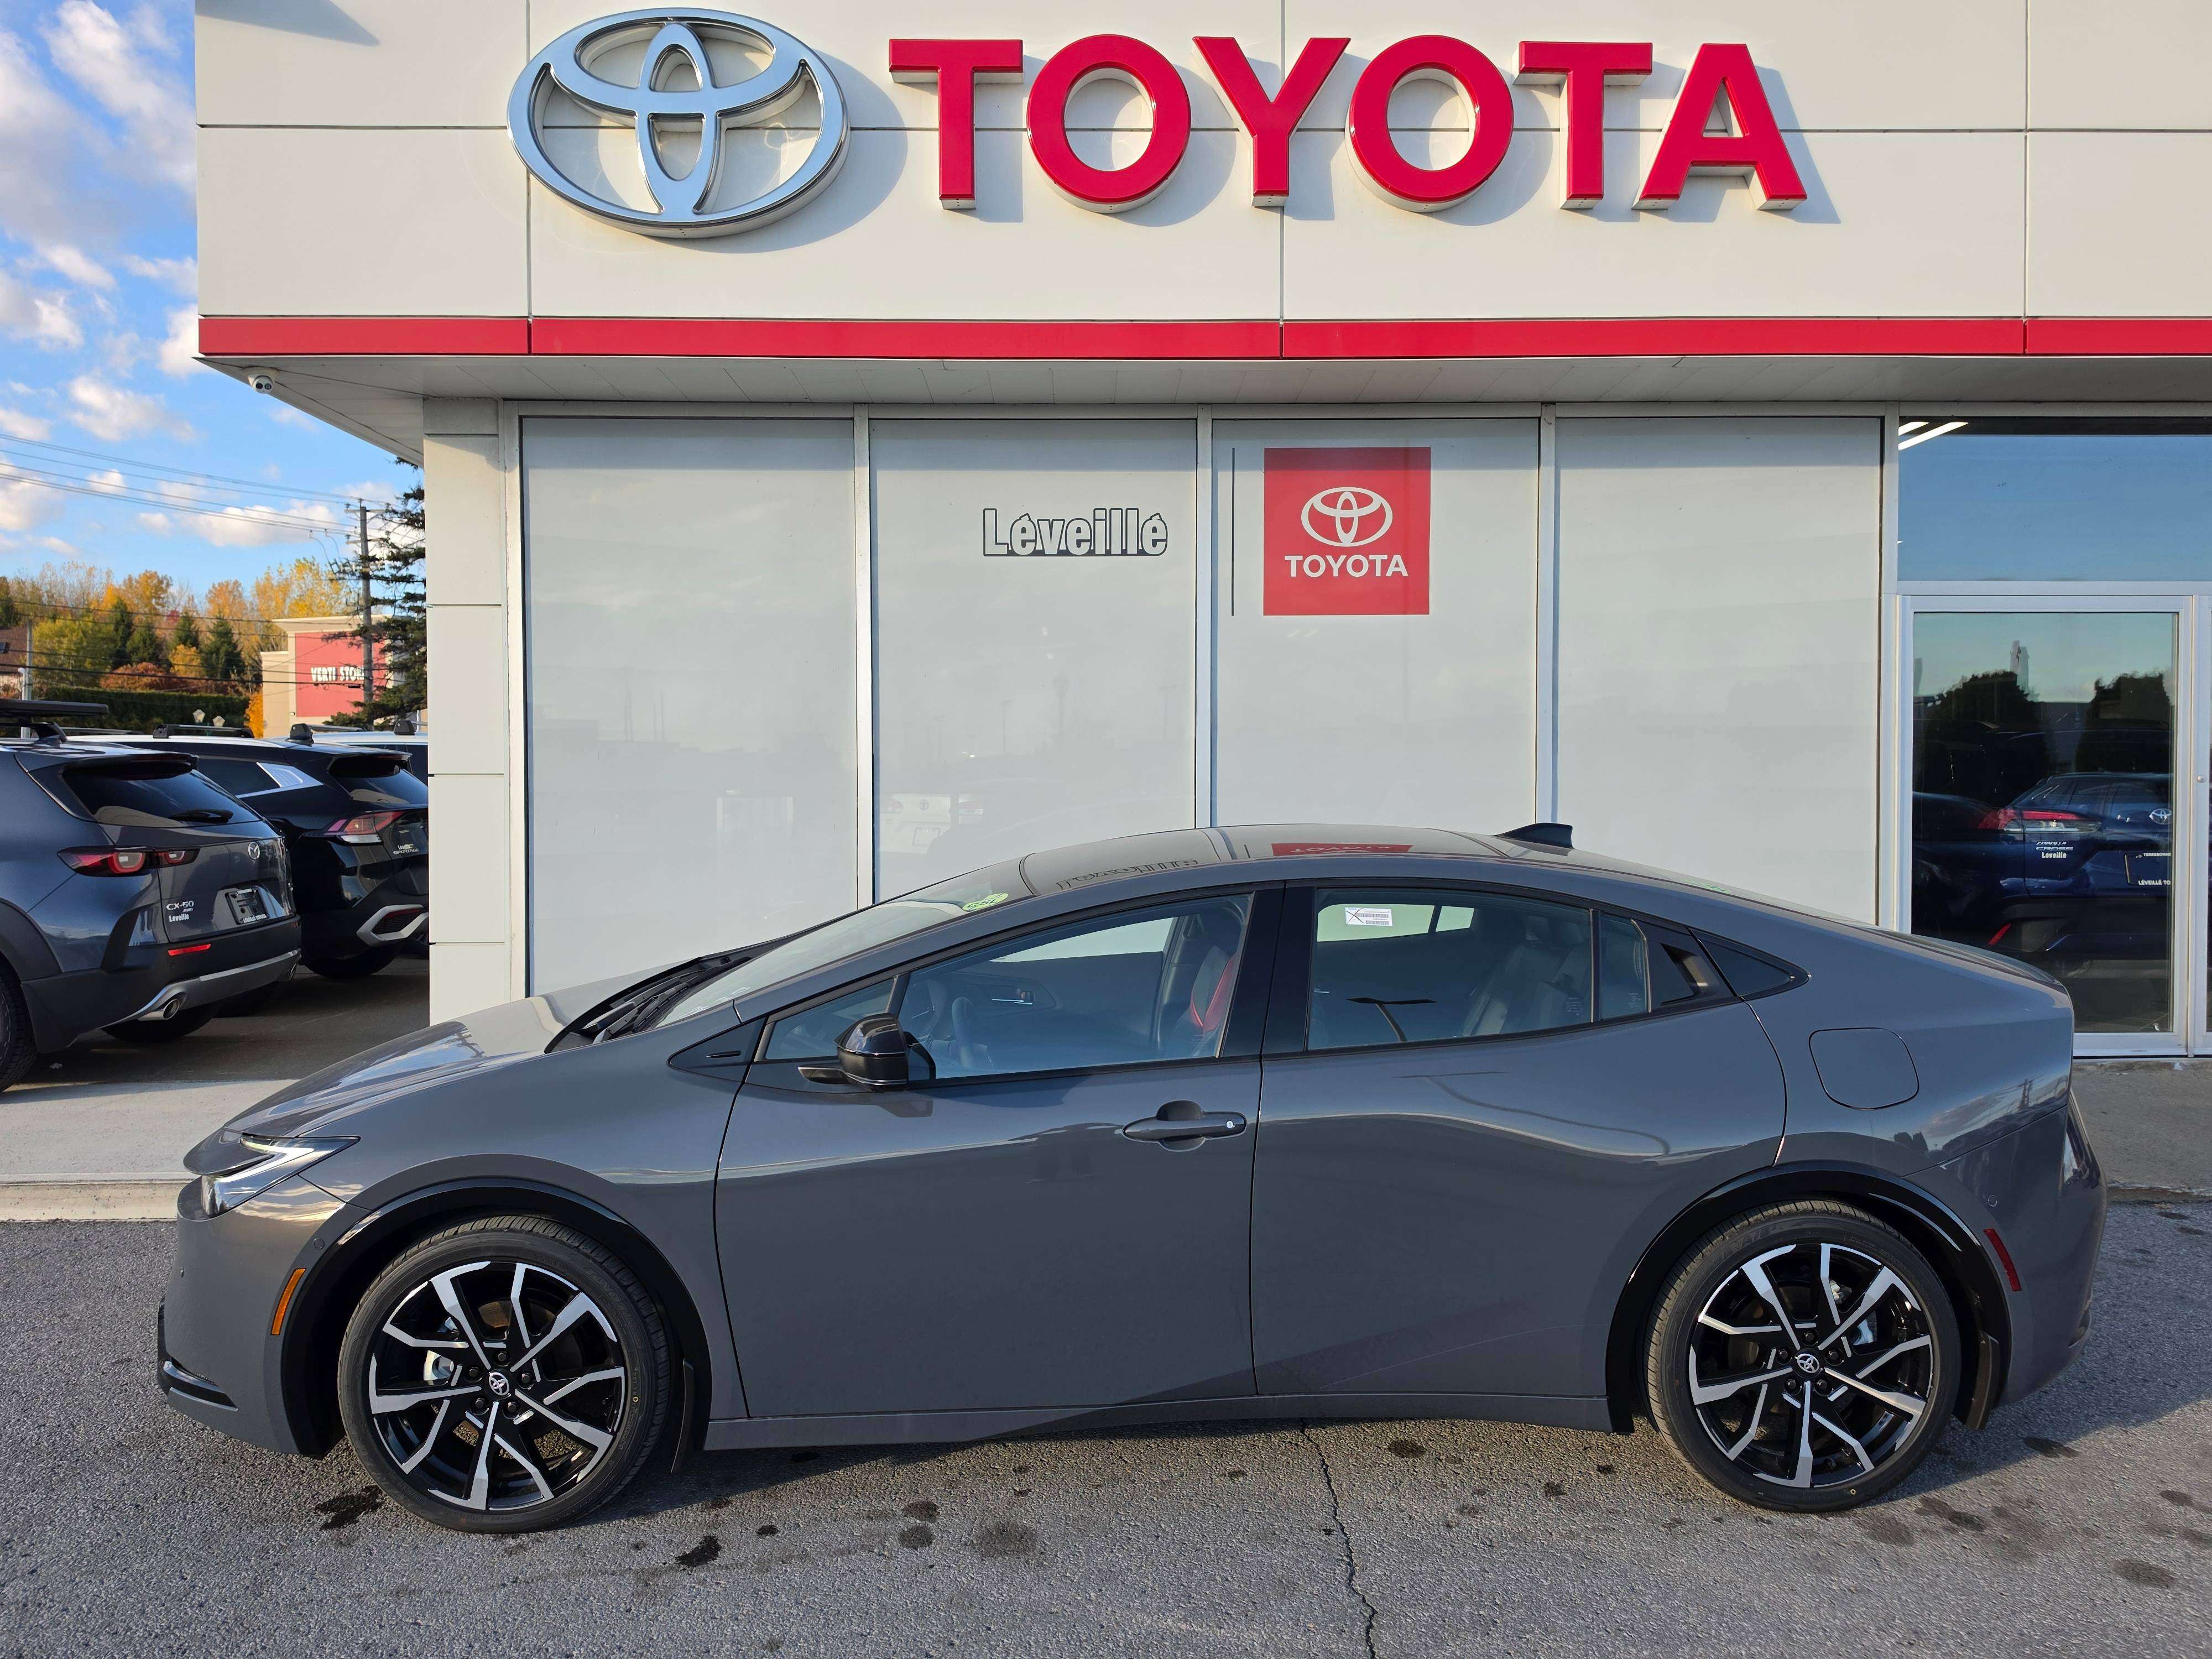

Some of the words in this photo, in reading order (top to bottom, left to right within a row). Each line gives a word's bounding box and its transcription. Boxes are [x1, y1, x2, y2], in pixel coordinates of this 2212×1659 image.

[889, 34, 1807, 210] TOYOTA
[983, 508, 1168, 556] Léveillé
[1284, 554, 1408, 577] TOYOTA
[311, 666, 337, 682] VERTI
[166, 900, 194, 911] CX-50
